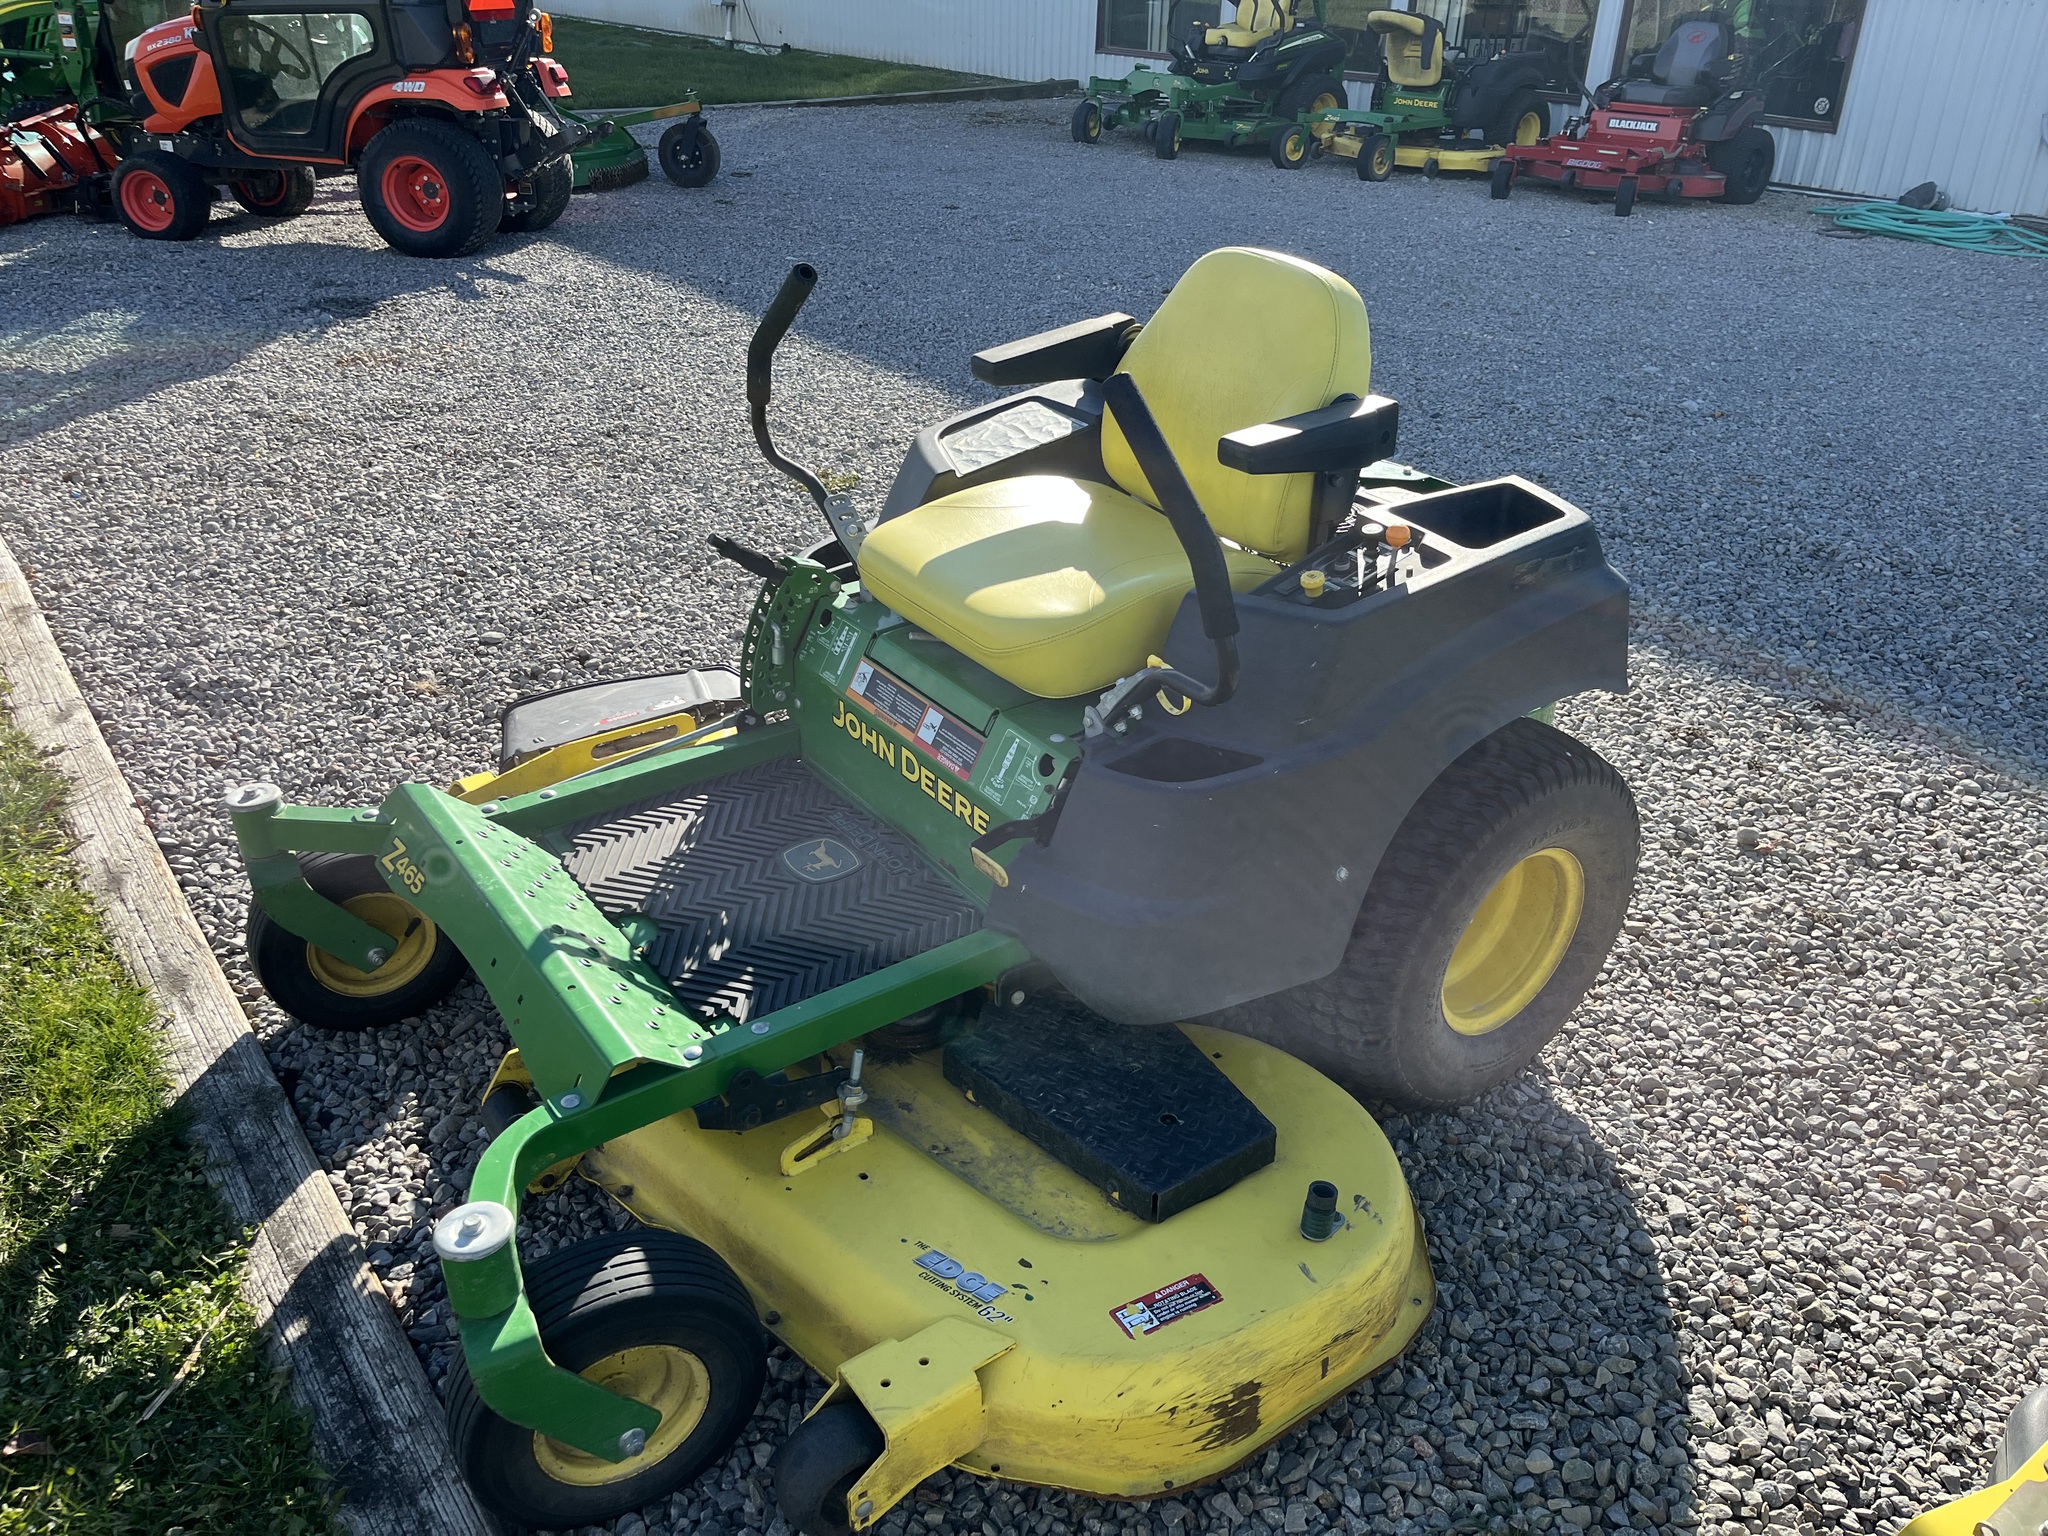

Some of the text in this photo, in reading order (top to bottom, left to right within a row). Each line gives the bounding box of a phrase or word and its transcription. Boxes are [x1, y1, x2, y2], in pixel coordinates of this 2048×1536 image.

[147, 36, 182, 51] BX2380
[391, 81, 426, 92] 4WD
[1394, 97, 1439, 109] JOHN DEERE
[1609, 118, 1658, 132] BLACKJACK
[832, 700, 990, 836] JOHN DEERE
[936, 754, 955, 770] DANGER
[381, 837, 426, 894] Z465
[914, 1240, 931, 1251] THE
[912, 1248, 1008, 1304] EDGE
[918, 1271, 953, 1293] CUTTING
[949, 1289, 984, 1310] SYSTEM
[1161, 1280, 1189, 1296] DANGER
[1153, 1285, 1198, 1308] ROTATING BLADE
[1156, 1309, 1170, 1318] under
